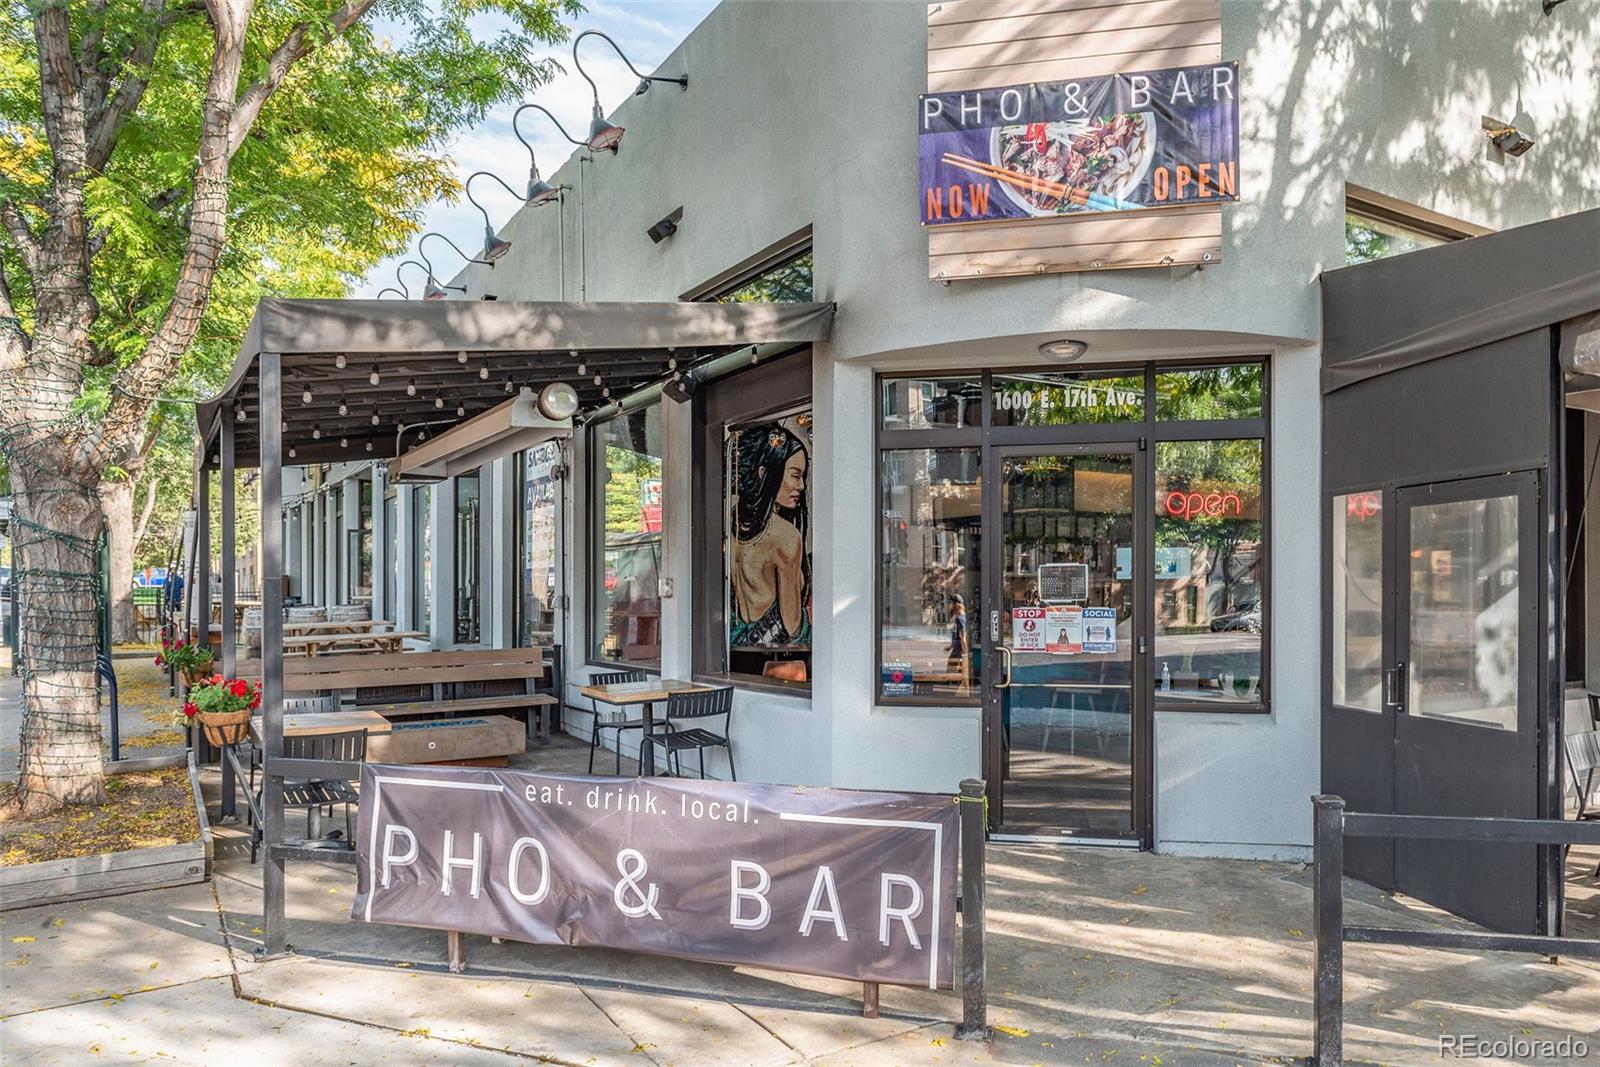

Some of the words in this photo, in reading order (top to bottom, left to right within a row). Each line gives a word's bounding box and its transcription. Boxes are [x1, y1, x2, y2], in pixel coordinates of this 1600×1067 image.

[924, 89, 1022, 129] PHO
[1063, 83, 1089, 115] &
[1131, 66, 1234, 109] BAR
[1154, 161, 1236, 200] OPEN
[927, 183, 990, 220] NOW
[995, 390, 1031, 410] 1600
[1041, 388, 1055, 409] E.
[1064, 385, 1098, 408] 17th
[1105, 387, 1142, 406] Ave.
[1166, 491, 1240, 520] open
[1018, 609, 1042, 618] STOP
[525, 784, 573, 806] eat.
[586, 786, 667, 815] drink.
[681, 794, 759, 824] local.
[380, 824, 550, 906] PHO
[613, 848, 663, 921] &
[729, 859, 924, 950] BAR
